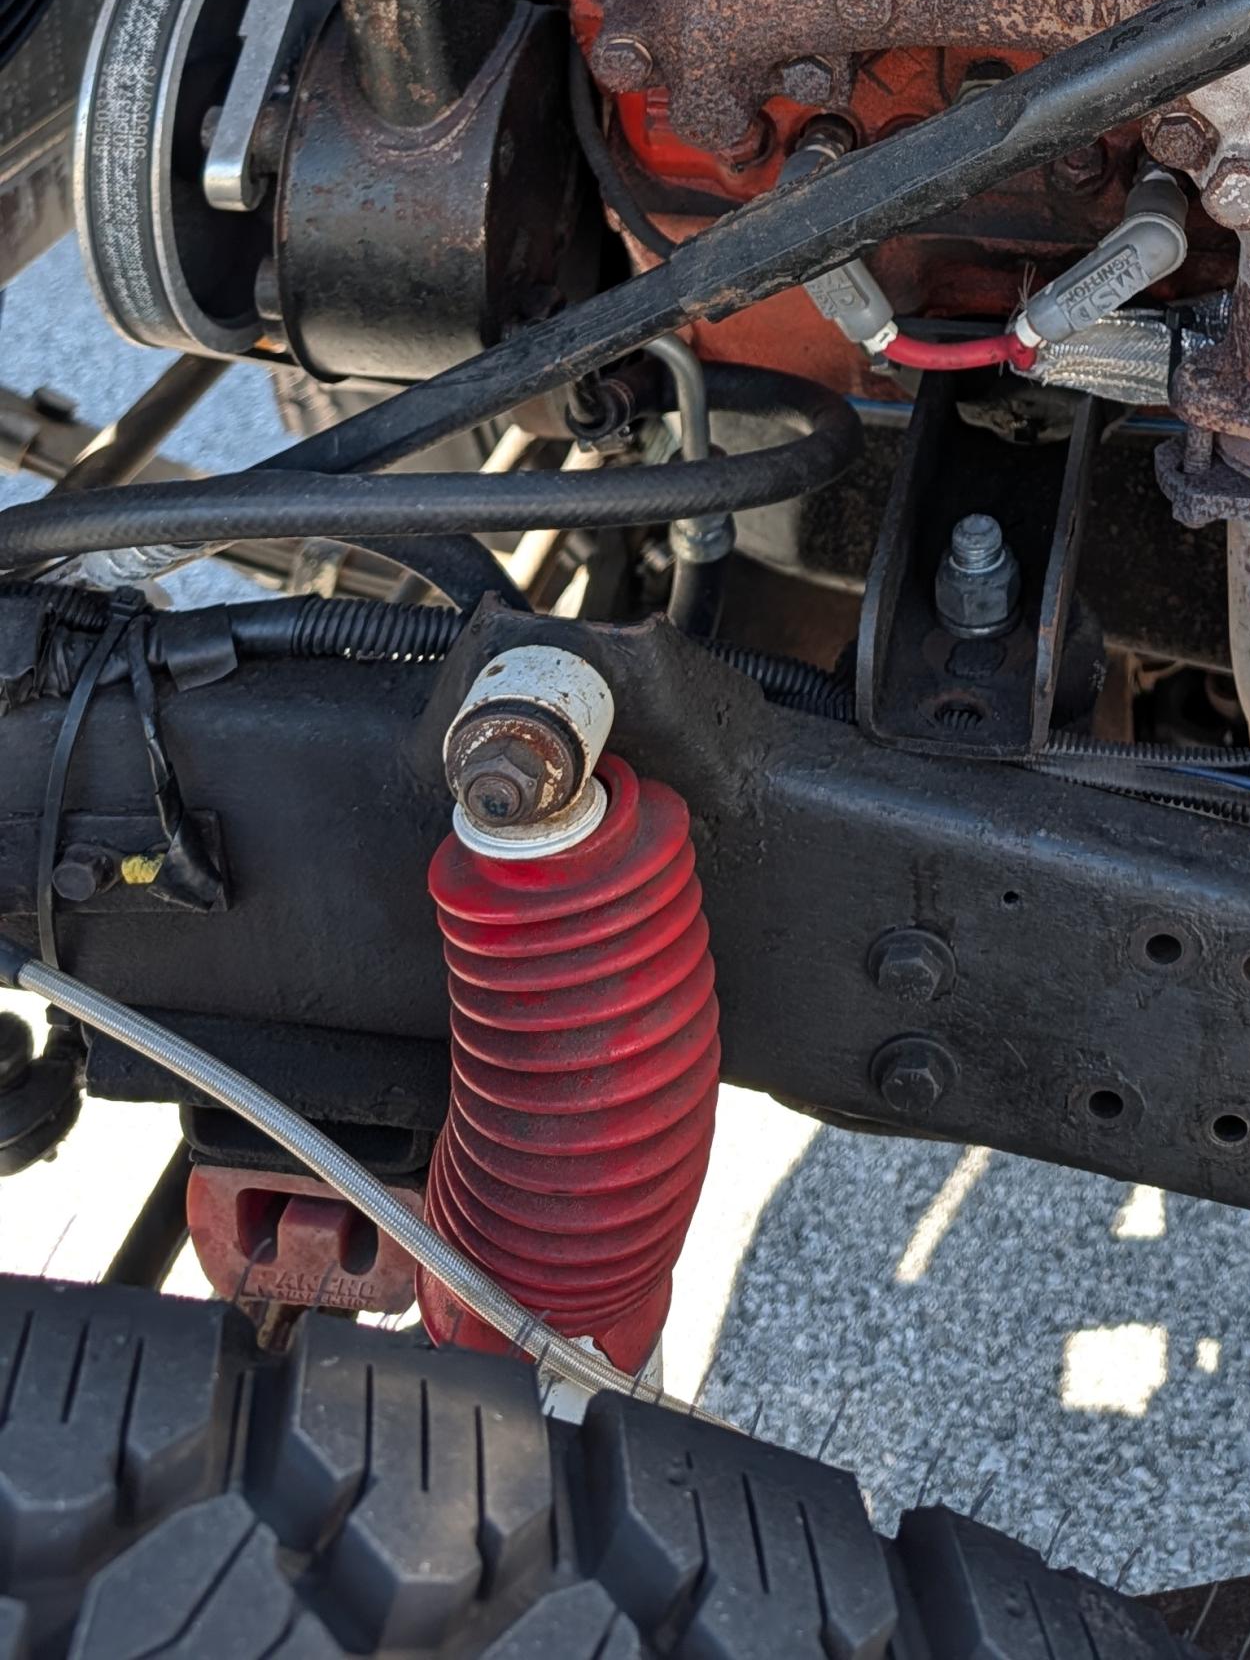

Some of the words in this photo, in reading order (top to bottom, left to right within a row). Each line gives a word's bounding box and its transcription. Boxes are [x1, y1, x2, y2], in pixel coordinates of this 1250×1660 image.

[1062, 254, 1131, 307] IGNITION
[1066, 263, 1149, 330] MSD
[240, 1266, 378, 1300] RANCHO
